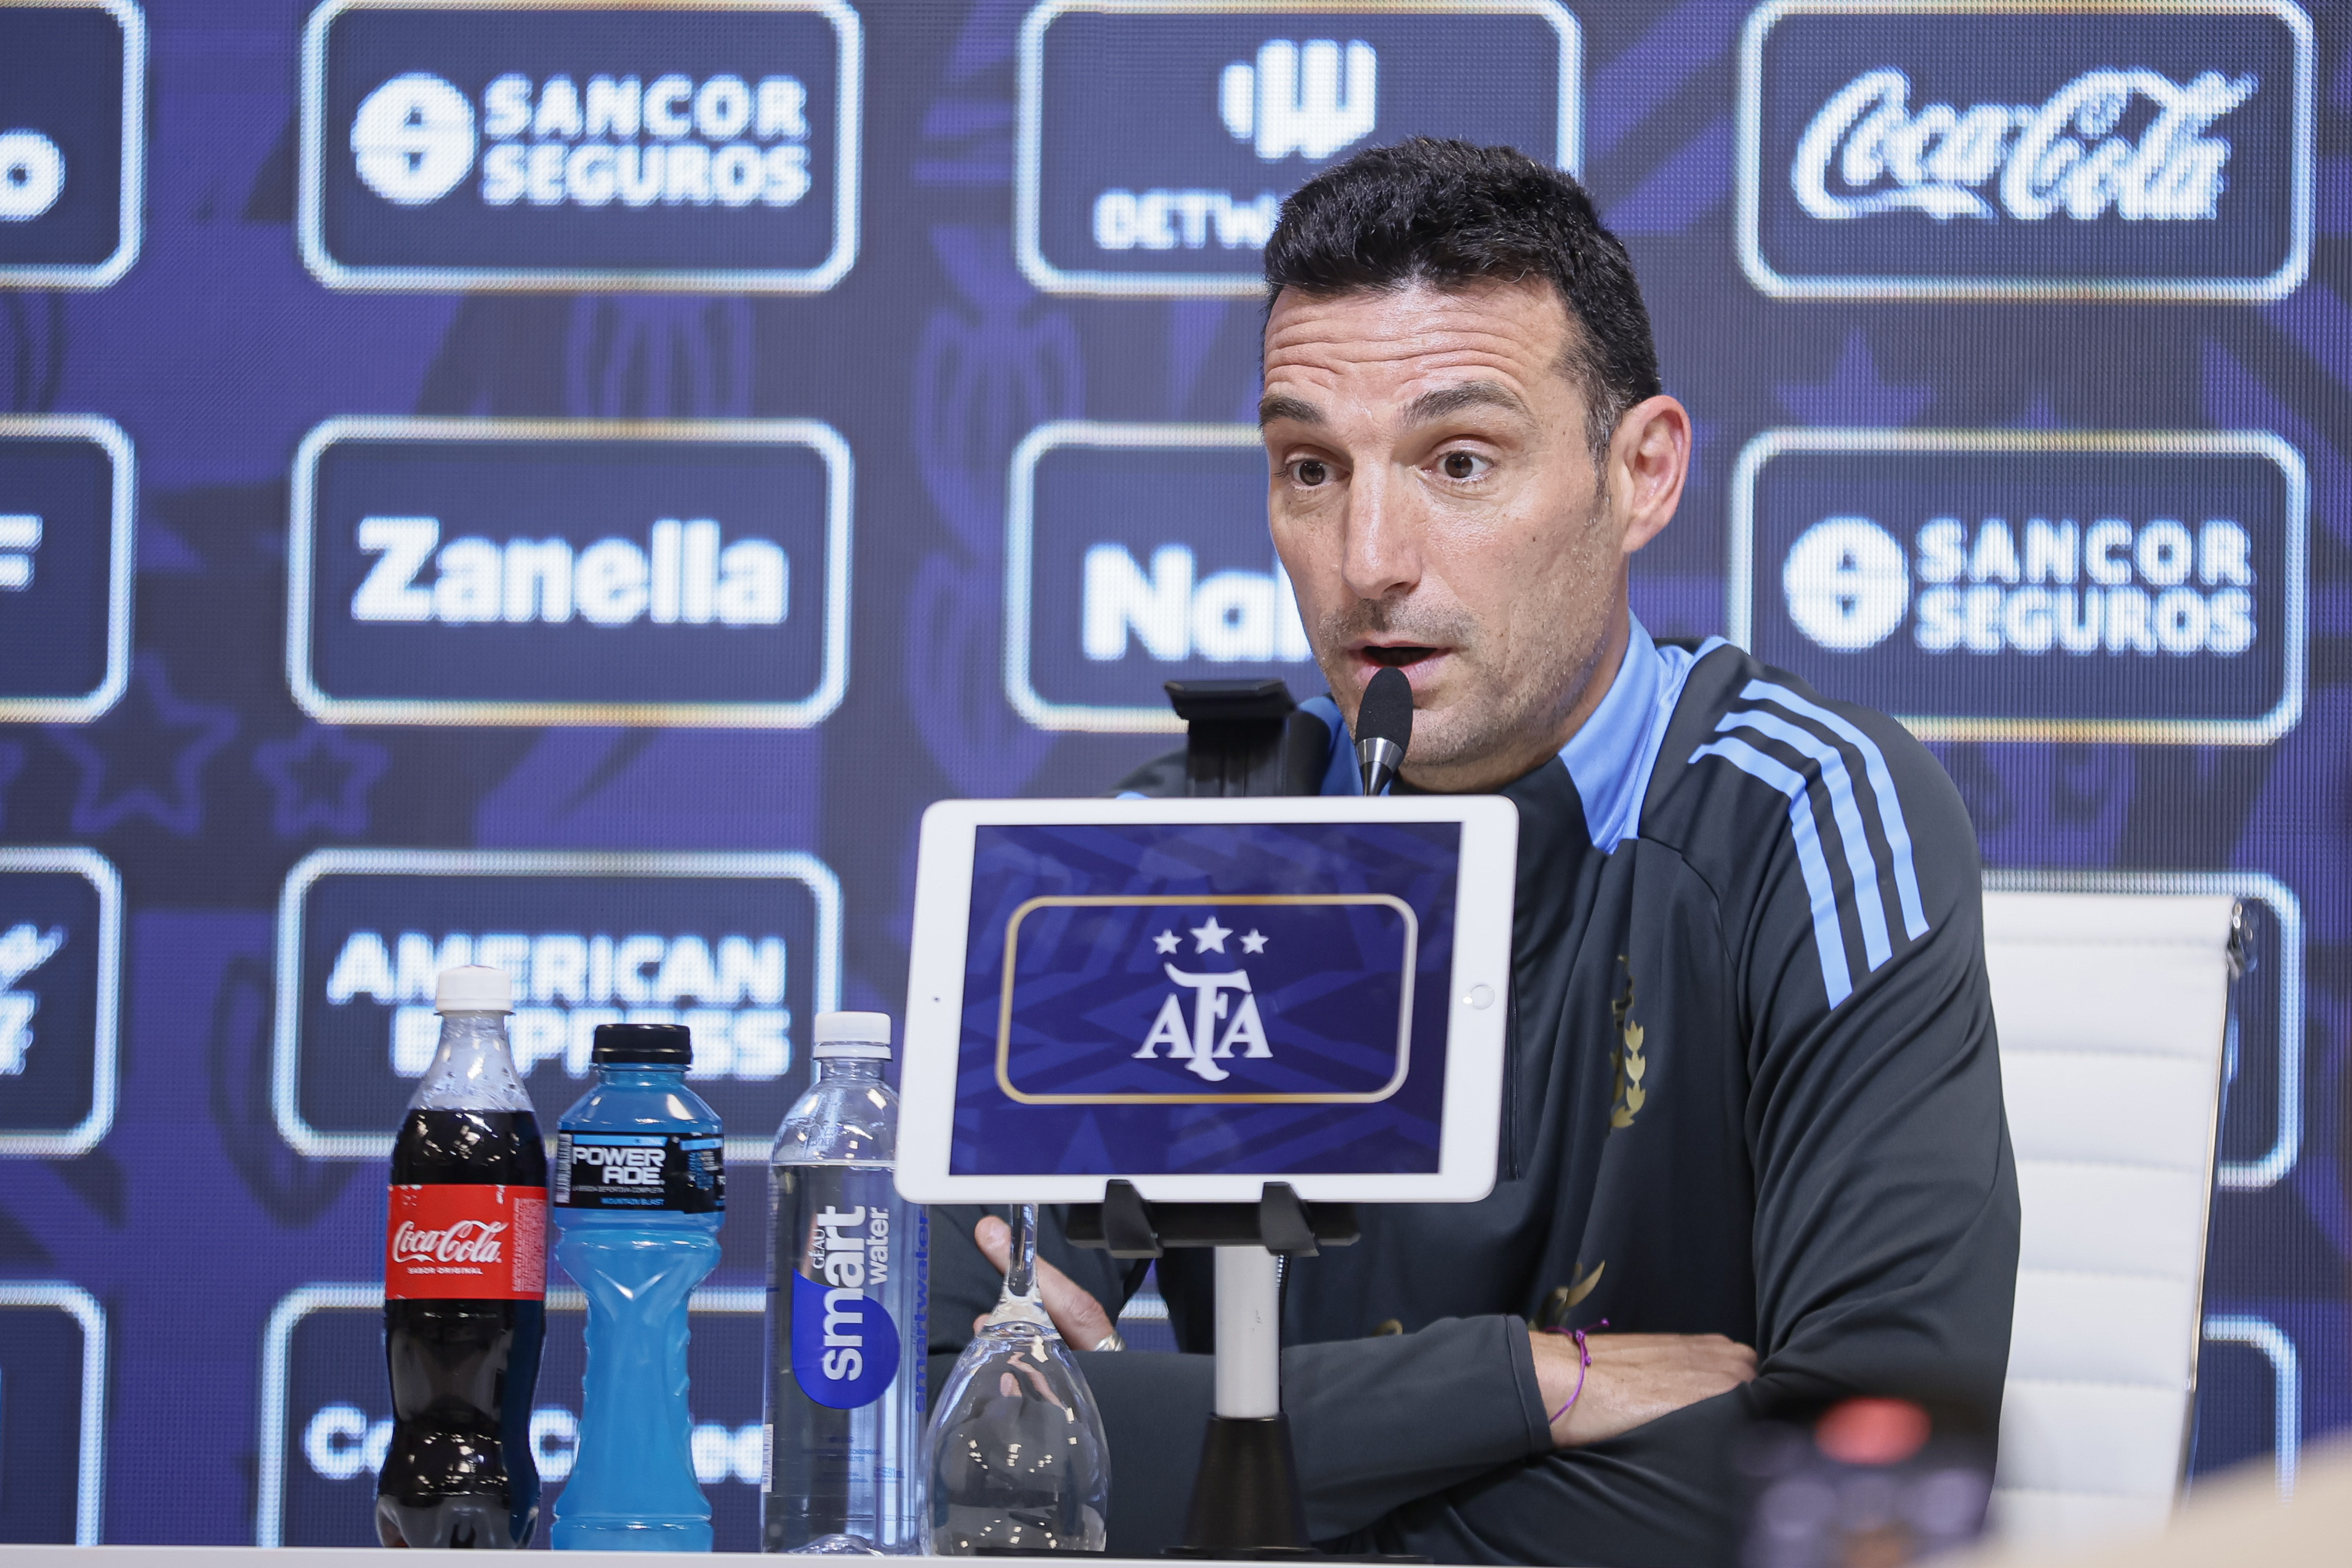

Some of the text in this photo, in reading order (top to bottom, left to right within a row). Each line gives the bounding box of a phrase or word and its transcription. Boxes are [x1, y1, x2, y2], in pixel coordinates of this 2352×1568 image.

[480, 73, 810, 140] SANCOR
[480, 141, 811, 206] SEGUROS
[352, 517, 788, 624] Zanella
[1915, 516, 2256, 586] SANCOR
[1914, 585, 2256, 656] SEGUROS
[1132, 962, 1273, 1081] AFA
[572, 1148, 666, 1167] POWER
[437, 1266, 484, 1274] ORIGINAL
[866, 1207, 889, 1285] water
[816, 1205, 866, 1381] smart
[914, 1210, 929, 1413] smartwater
